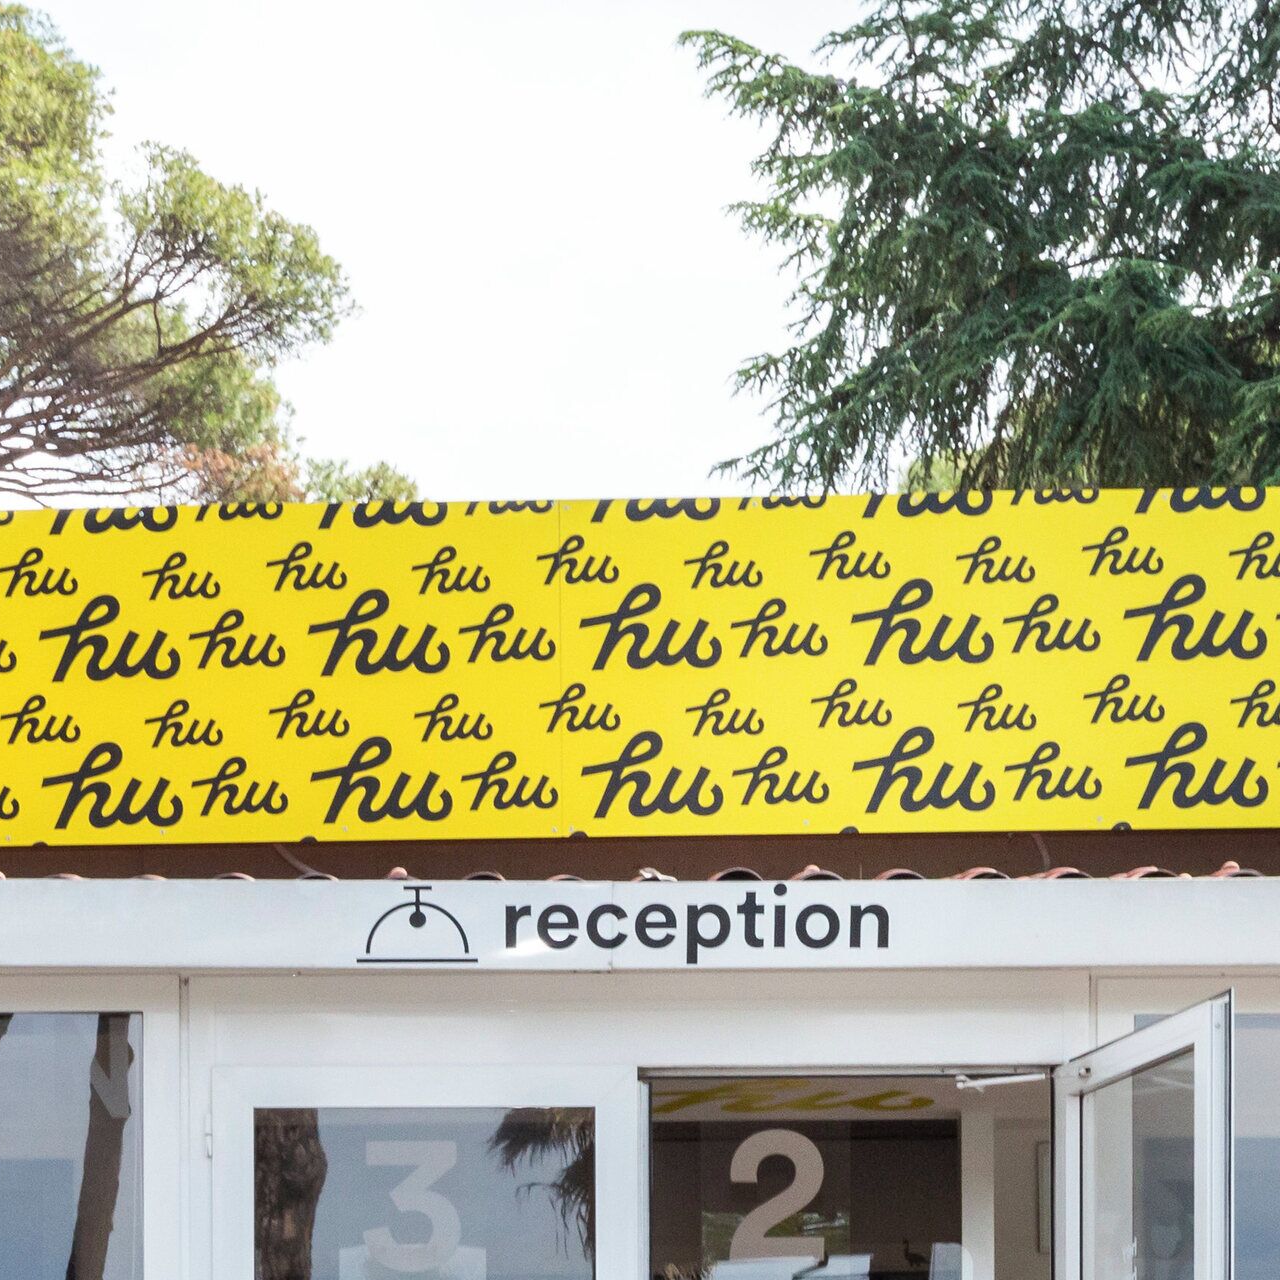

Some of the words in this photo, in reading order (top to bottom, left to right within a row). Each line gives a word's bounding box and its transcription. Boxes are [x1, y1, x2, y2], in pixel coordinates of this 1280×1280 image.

[0, 548, 77, 597] hu
[143, 552, 220, 599] hu
[267, 542, 346, 591] hu
[413, 547, 490, 594] hu
[537, 536, 618, 584] hu
[685, 541, 762, 588] hu
[810, 531, 890, 579] hu
[957, 537, 1035, 583] hu
[1083, 527, 1163, 575] hu
[40, 595, 180, 681] hu
[189, 610, 285, 668] hu
[309, 590, 449, 676] hu
[459, 604, 555, 662] hu
[580, 584, 721, 670] hu
[731, 599, 827, 657] hu
[852, 579, 993, 665] hu
[1003, 594, 1100, 652] hu
[1124, 575, 1267, 661] hu
[1, 695, 80, 743] hu
[145, 700, 222, 747] hu
[270, 690, 349, 738] hu
[415, 694, 492, 741] hu
[540, 684, 620, 732] hu
[686, 689, 764, 735] hu
[812, 679, 891, 727] hu
[958, 684, 1036, 731] hu
[1084, 675, 1164, 723] hu
[42, 743, 183, 828] hu
[192, 757, 288, 815] hu
[311, 737, 452, 823] hu
[462, 752, 558, 810] hu
[582, 732, 723, 818] hu
[733, 747, 829, 804] hu
[853, 727, 995, 812] hu
[1005, 742, 1101, 800] hu
[1126, 723, 1268, 809] hu
[504, 883, 890, 964] reception
[363, 1140, 462, 1273] 3
[729, 1128, 825, 1262] 2
